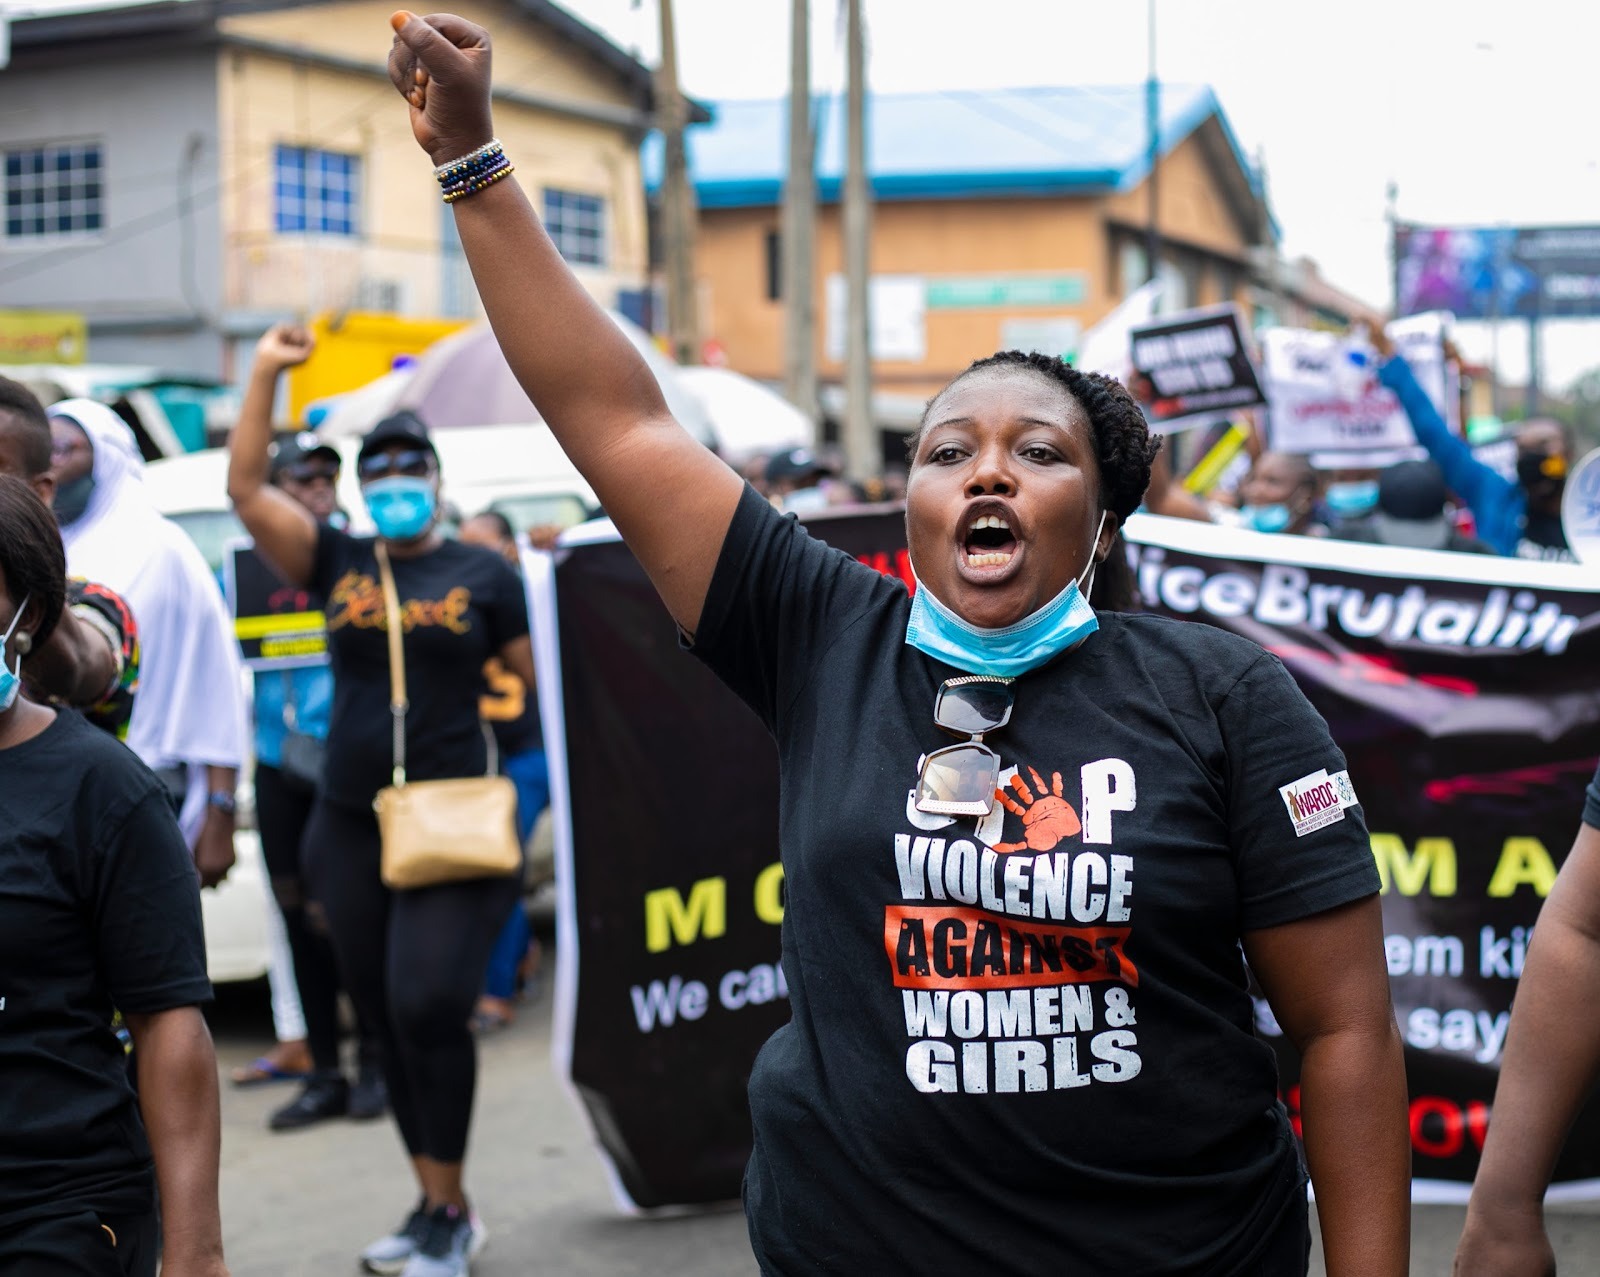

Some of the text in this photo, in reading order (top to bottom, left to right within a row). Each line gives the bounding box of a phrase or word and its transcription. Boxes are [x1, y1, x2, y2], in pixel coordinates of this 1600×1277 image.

[1295, 782, 1338, 817] WARDC
[894, 833, 1134, 922] VIOLENCE
[897, 917, 1124, 978] AGAINST
[630, 974, 709, 1034] We
[1479, 925, 1534, 978] ki
[901, 985, 1138, 1038] WOMEN &
[905, 1029, 1143, 1094] GIRLS
